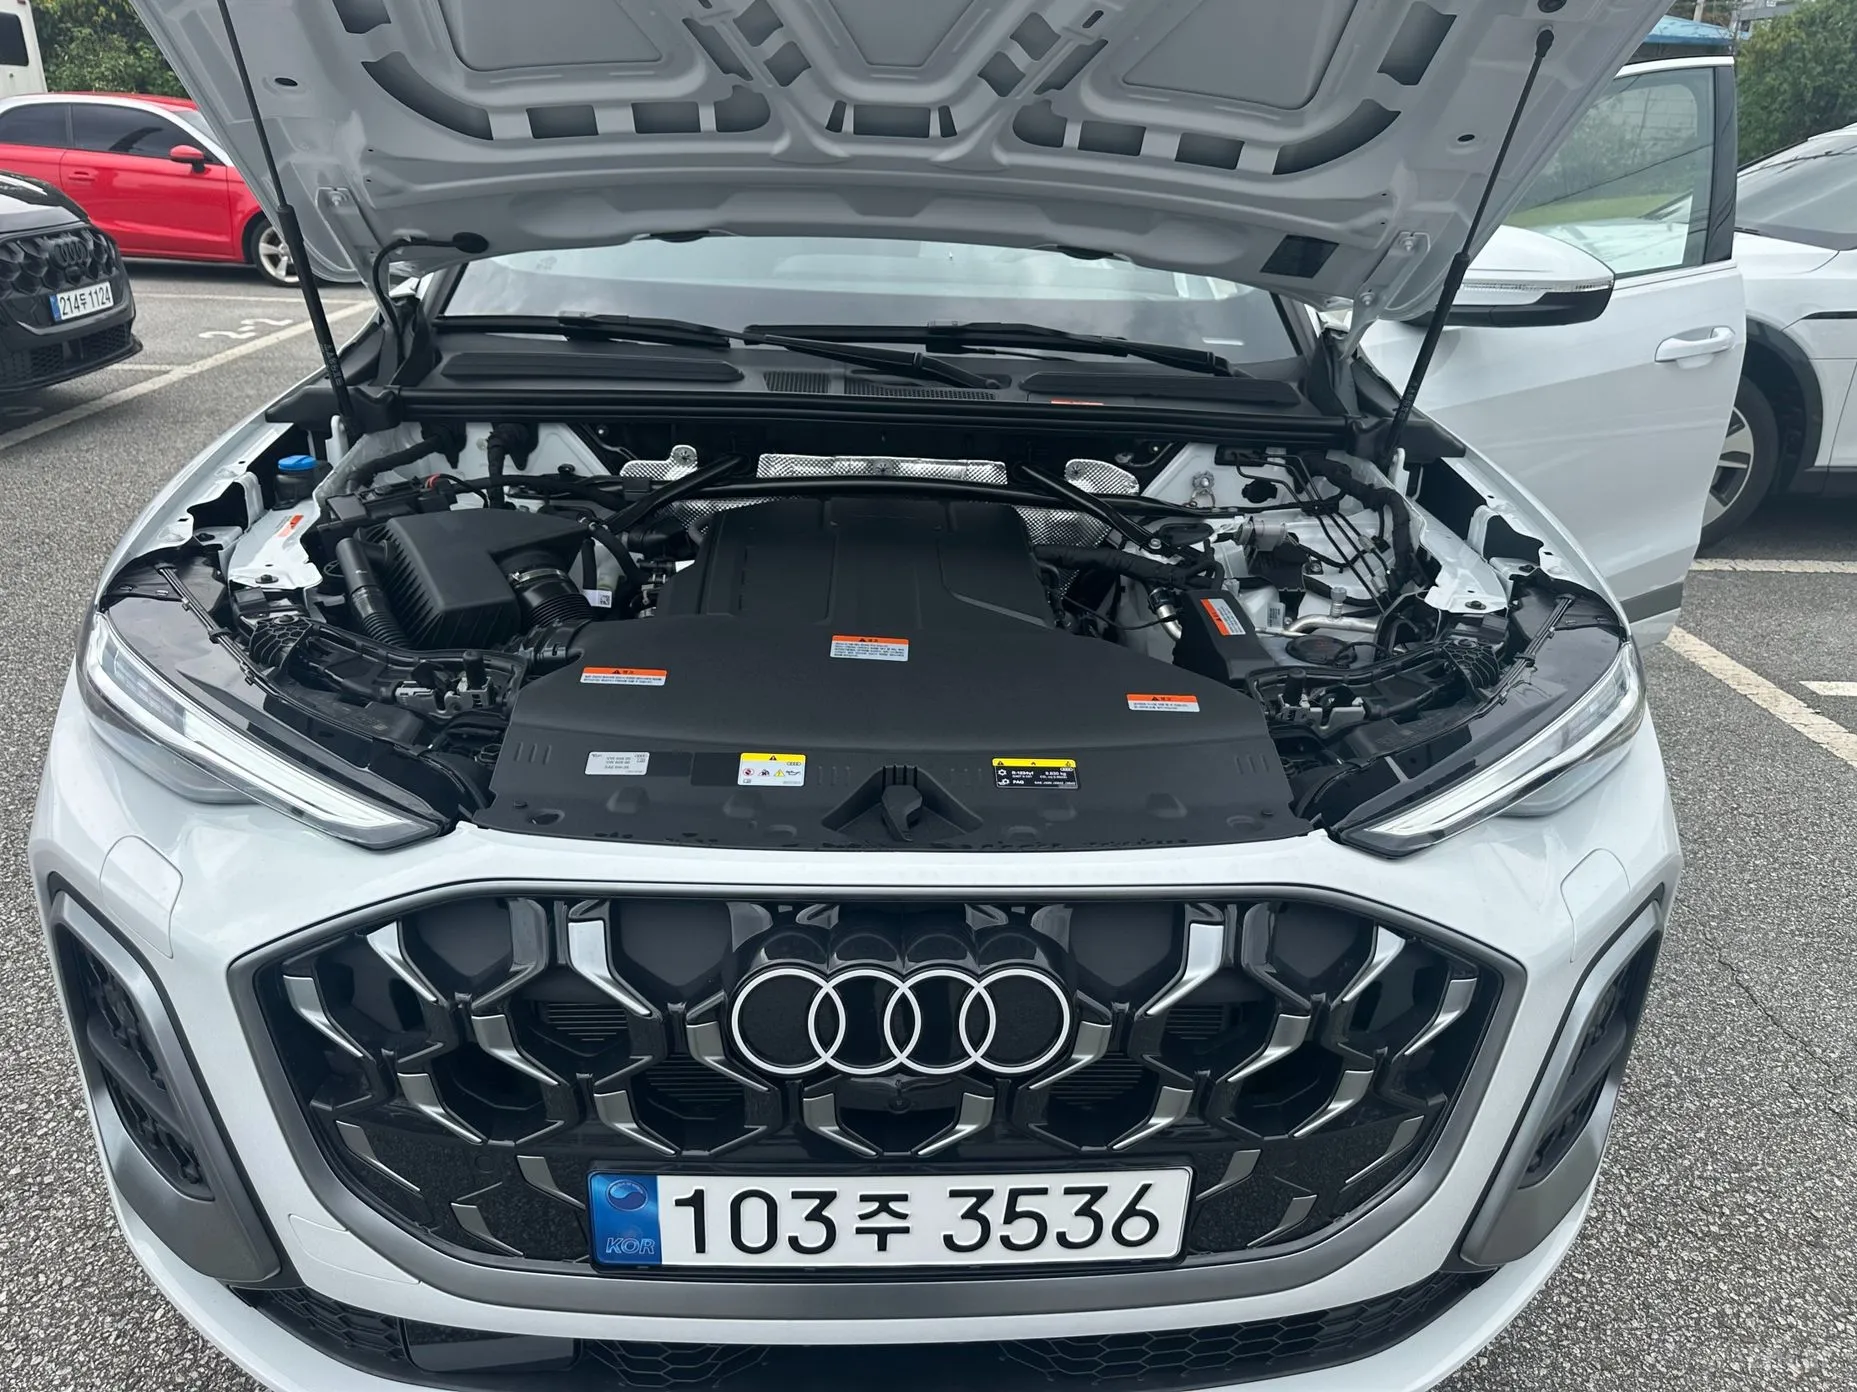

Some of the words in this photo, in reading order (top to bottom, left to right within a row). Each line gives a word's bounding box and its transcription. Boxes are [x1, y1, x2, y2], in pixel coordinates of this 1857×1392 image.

[89, 285, 111, 308] 1124
[673, 1187, 912, 1254] 103주
[942, 1182, 1161, 1253] 3536
[605, 1237, 656, 1255] KOR
